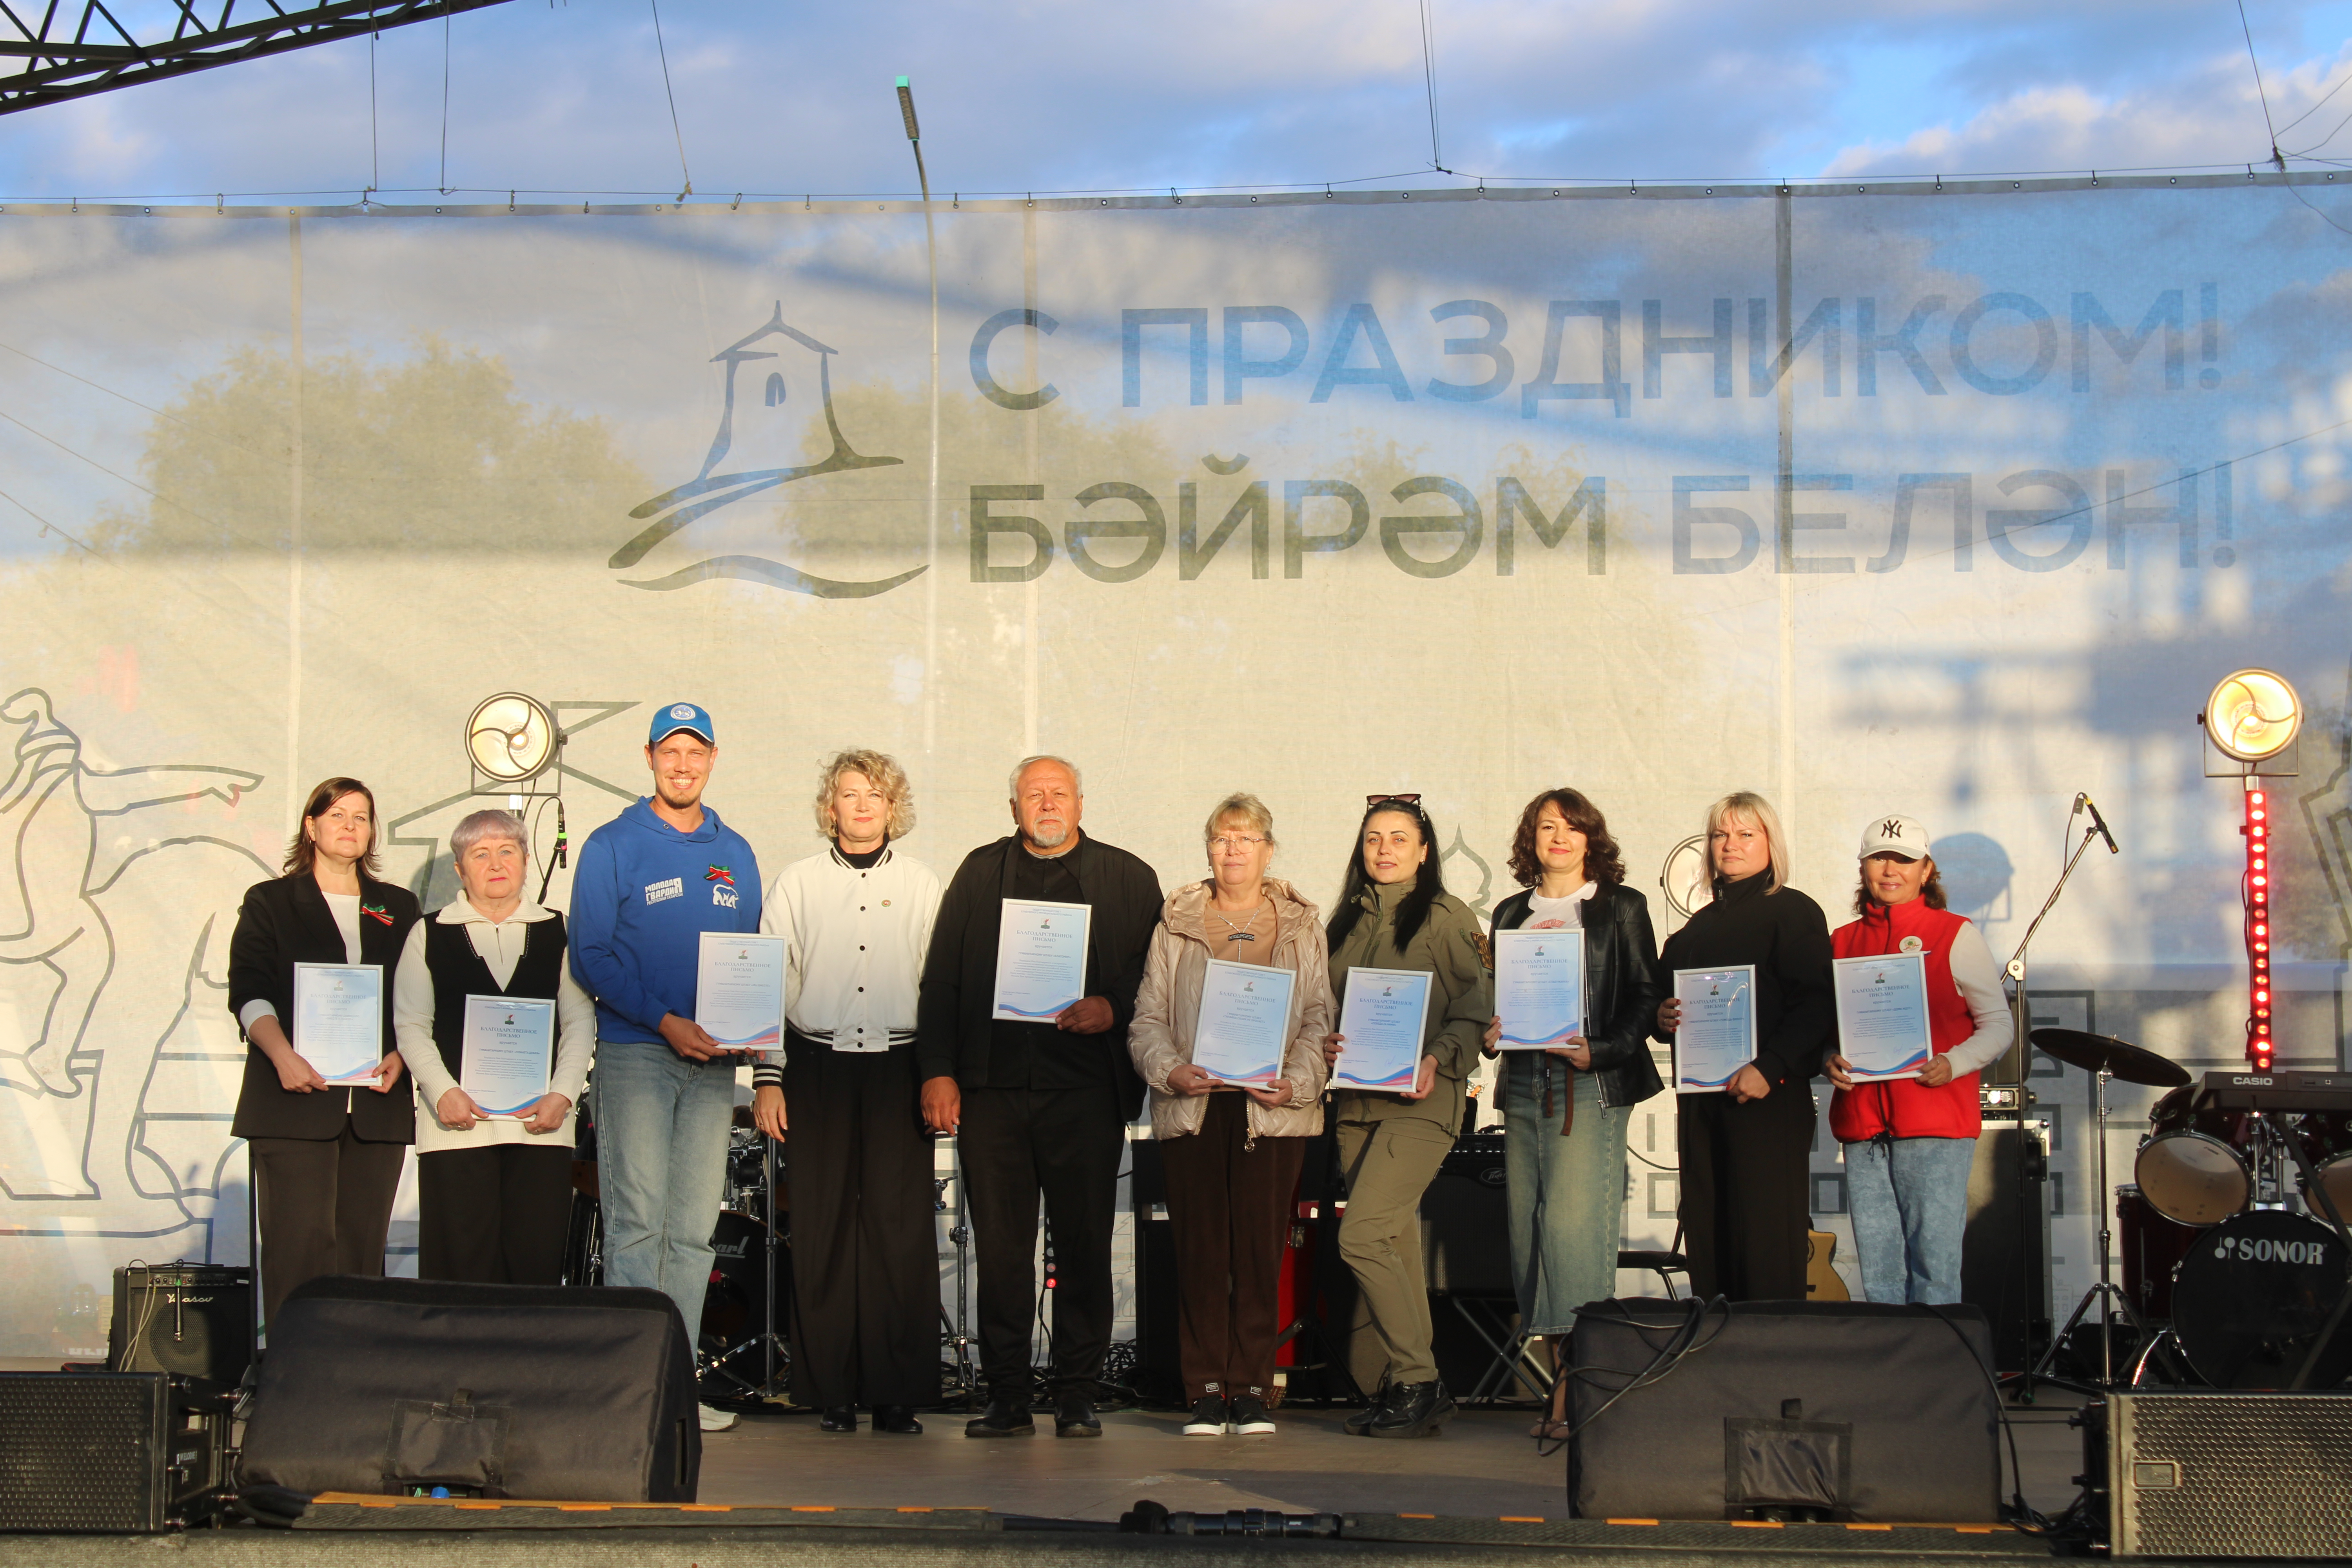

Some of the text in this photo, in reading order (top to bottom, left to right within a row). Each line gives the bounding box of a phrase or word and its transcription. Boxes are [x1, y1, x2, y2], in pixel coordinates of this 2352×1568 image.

[969, 282, 2225, 420] С ПРАЗДНИКОМ!
[970, 453, 2238, 584] БӘЙРӘМ БЕЛӘН!
[1881, 819, 1902, 838] NY
[647, 896, 666, 906] РЕСПУБЛИКИ
[1016, 930, 1073, 938] БЛАГОДАРСТВЕННОЕ
[1852, 985, 1909, 993] БЛАГОДАРСТВЕННОЕ
[1220, 991, 1275, 1003] БЛАГОДАРСТВЕННОЕ
[2233, 1077, 2273, 1086] CASIO
[711, 1232, 749, 1254] arl
[2239, 1238, 2323, 1265] SONOR
[167, 1294, 213, 1303] Yasov
